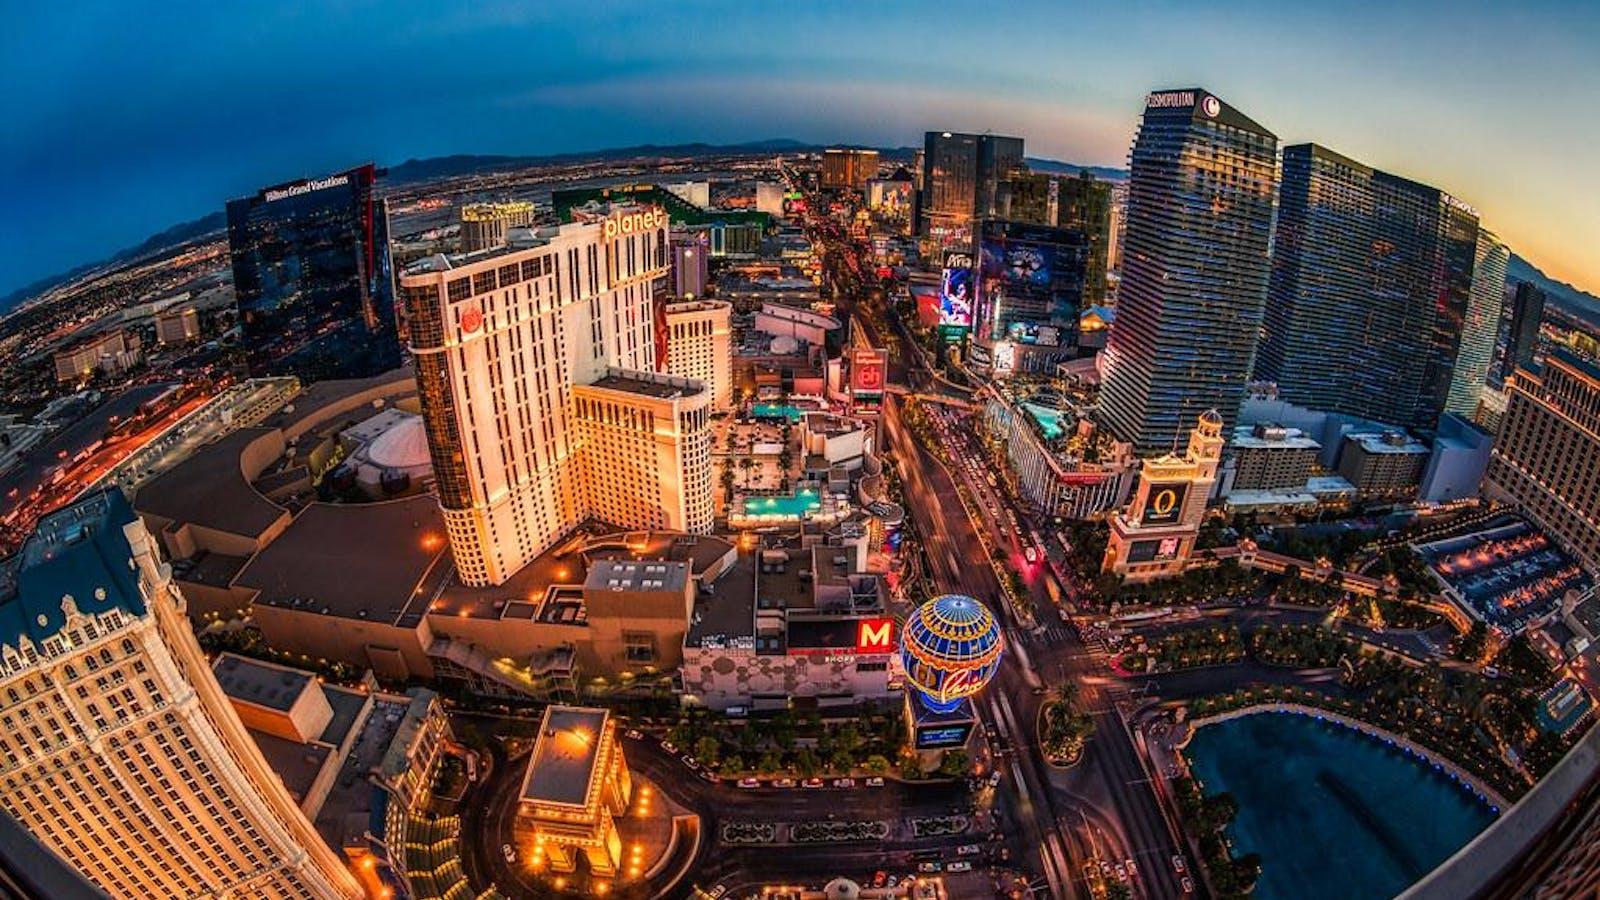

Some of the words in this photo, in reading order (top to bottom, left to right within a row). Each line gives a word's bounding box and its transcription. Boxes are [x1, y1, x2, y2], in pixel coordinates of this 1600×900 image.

[1147, 92, 1194, 108] COSMOPOLITAN
[288, 182, 311, 197] Grand
[311, 176, 348, 190] Vacations
[605, 206, 663, 243] planet
[861, 623, 891, 648] M
